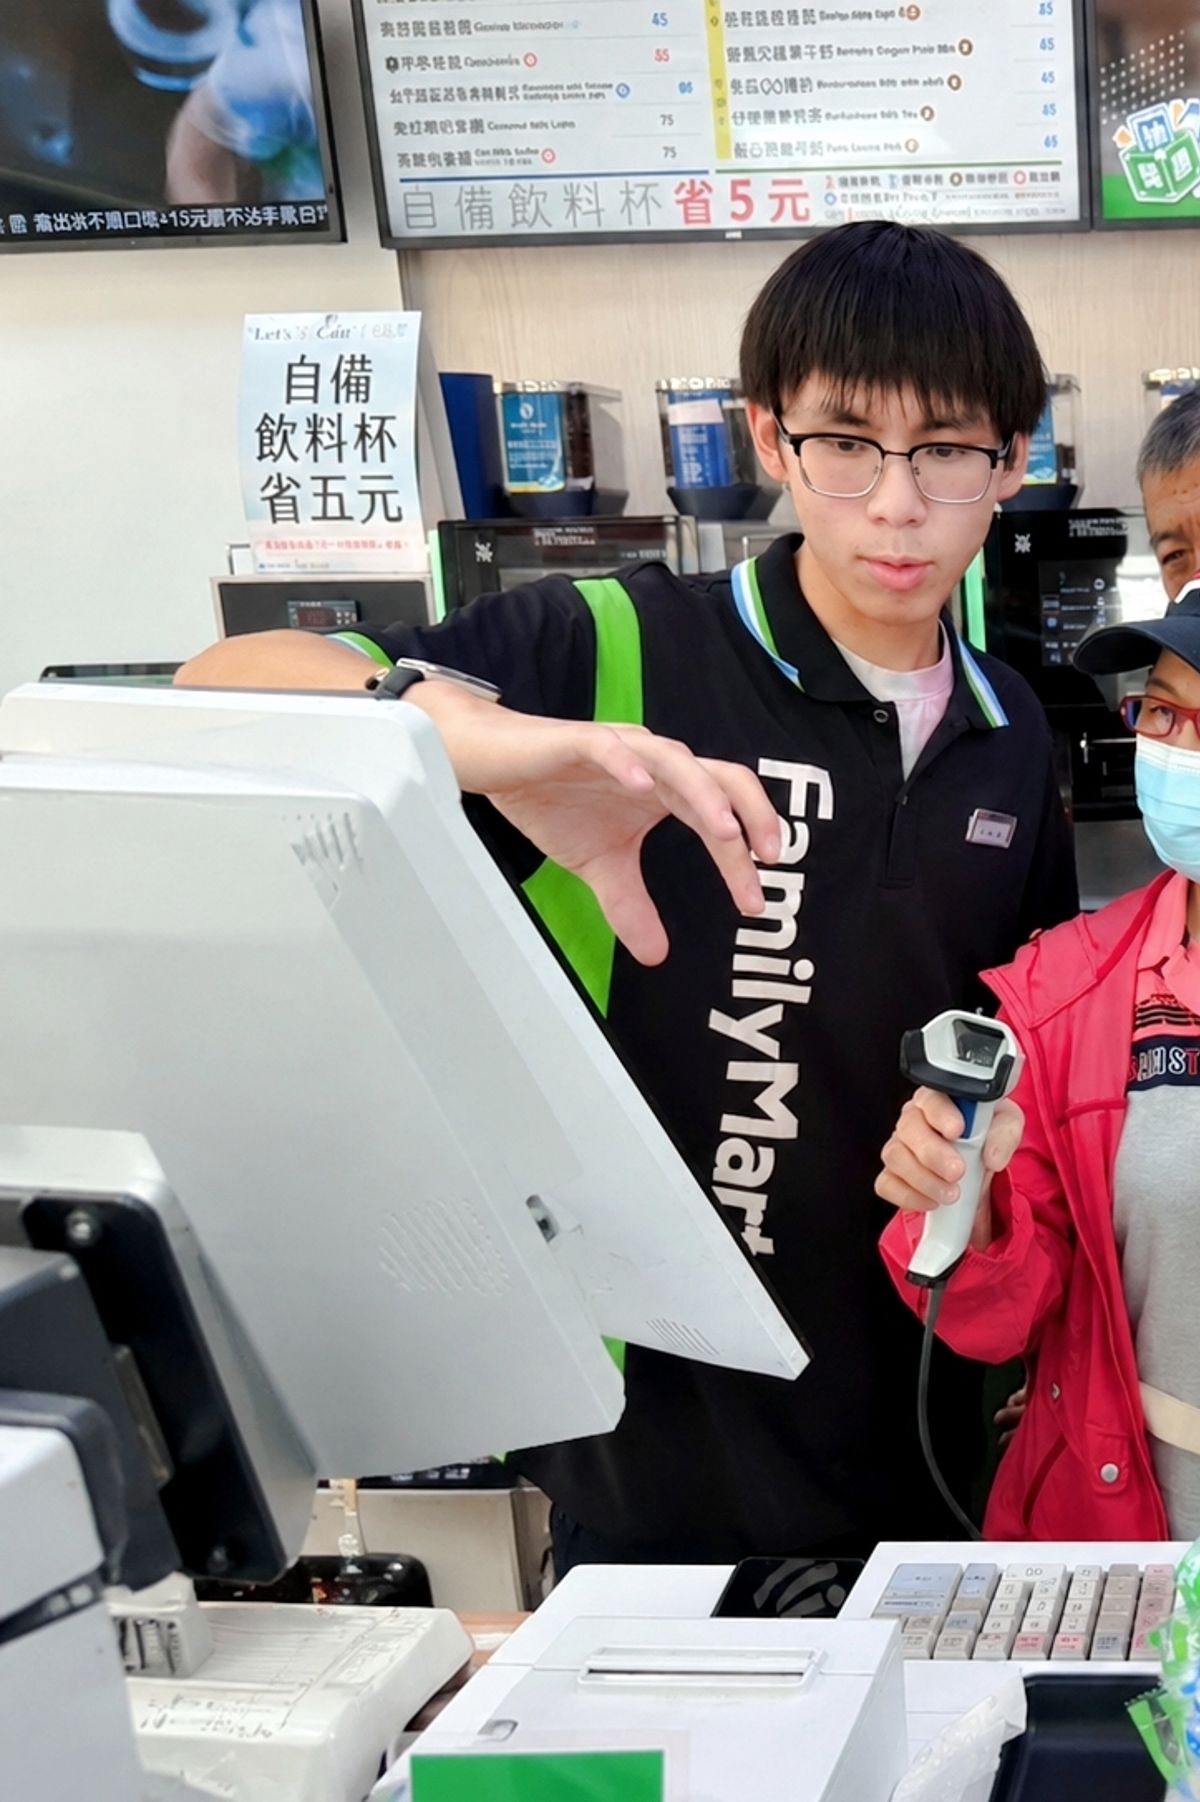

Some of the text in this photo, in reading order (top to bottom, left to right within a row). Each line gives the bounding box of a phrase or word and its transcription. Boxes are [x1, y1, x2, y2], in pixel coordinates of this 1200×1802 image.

[652, 12, 668, 26] 45
[660, 114, 675, 126] 75
[663, 146, 677, 159] 75
[285, 353, 373, 404] 自備
[255, 412, 397, 464] 飲料杯
[259, 472, 404, 525] 省五元
